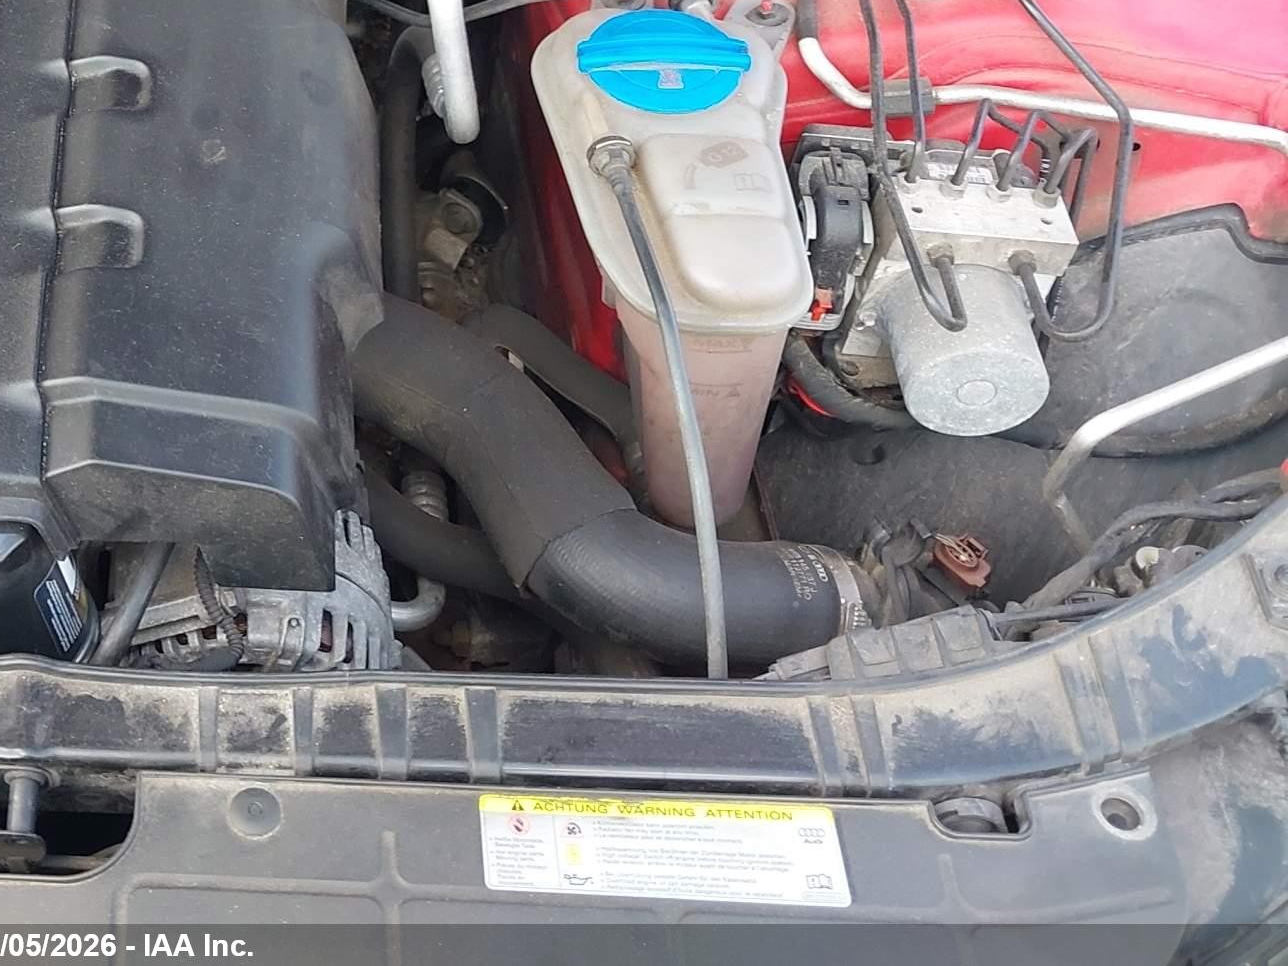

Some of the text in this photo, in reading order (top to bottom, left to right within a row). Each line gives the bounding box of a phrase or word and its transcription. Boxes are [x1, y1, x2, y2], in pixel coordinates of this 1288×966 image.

[532, 801, 794, 821] ACHTUNG WARNING ATTENTION
